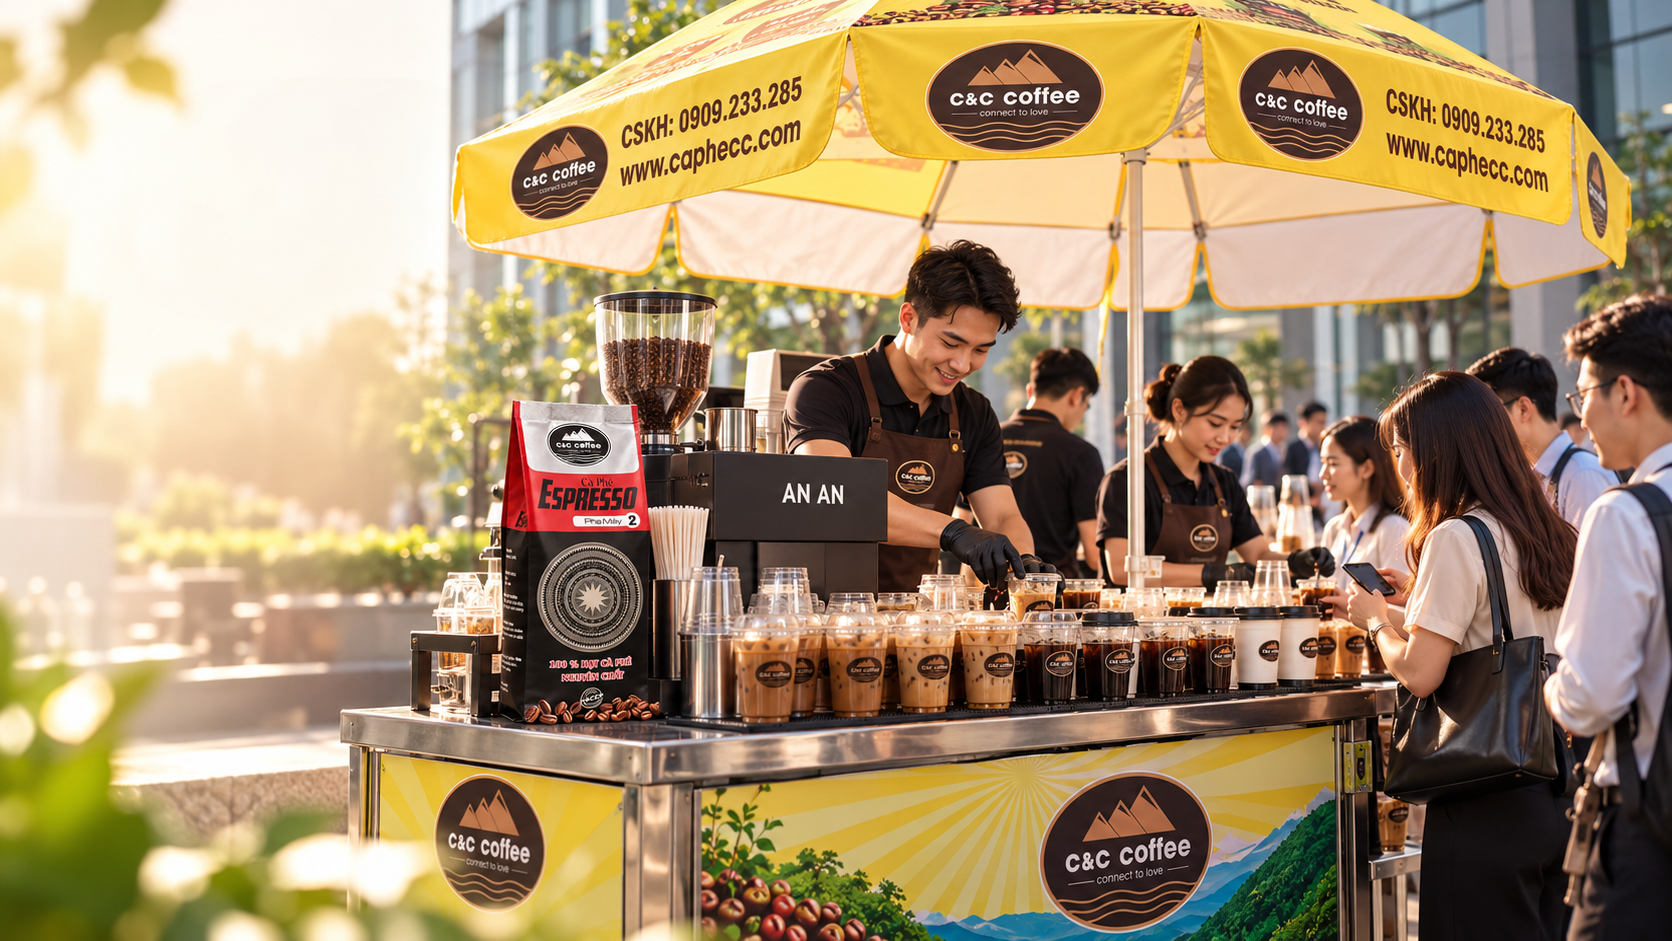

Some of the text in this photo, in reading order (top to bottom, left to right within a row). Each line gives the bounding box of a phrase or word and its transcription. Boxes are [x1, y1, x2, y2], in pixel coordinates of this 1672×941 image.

[950, 87, 1080, 106] C&C coffee
[1255, 92, 1348, 120] C&C coffee
[622, 76, 802, 148] CSKH: 0909.233.285
[980, 109, 1015, 117] connect
[1030, 108, 1048, 116] love
[1386, 89, 1545, 153] CSKH: 0909.233.285
[620, 120, 801, 186] www.caphecc.com
[1386, 132, 1548, 192] www.caphecc.com
[523, 161, 596, 188] C&C coffee
[538, 478, 638, 510] ESPRESSO
[782, 482, 843, 504] AN AN
[628, 515, 637, 526] 2
[549, 660, 568, 668] 100
[569, 660, 579, 669] %
[448, 832, 530, 864] C&C coffee
[1065, 836, 1191, 873] C&C coffee
[1097, 867, 1163, 885] connect to love
